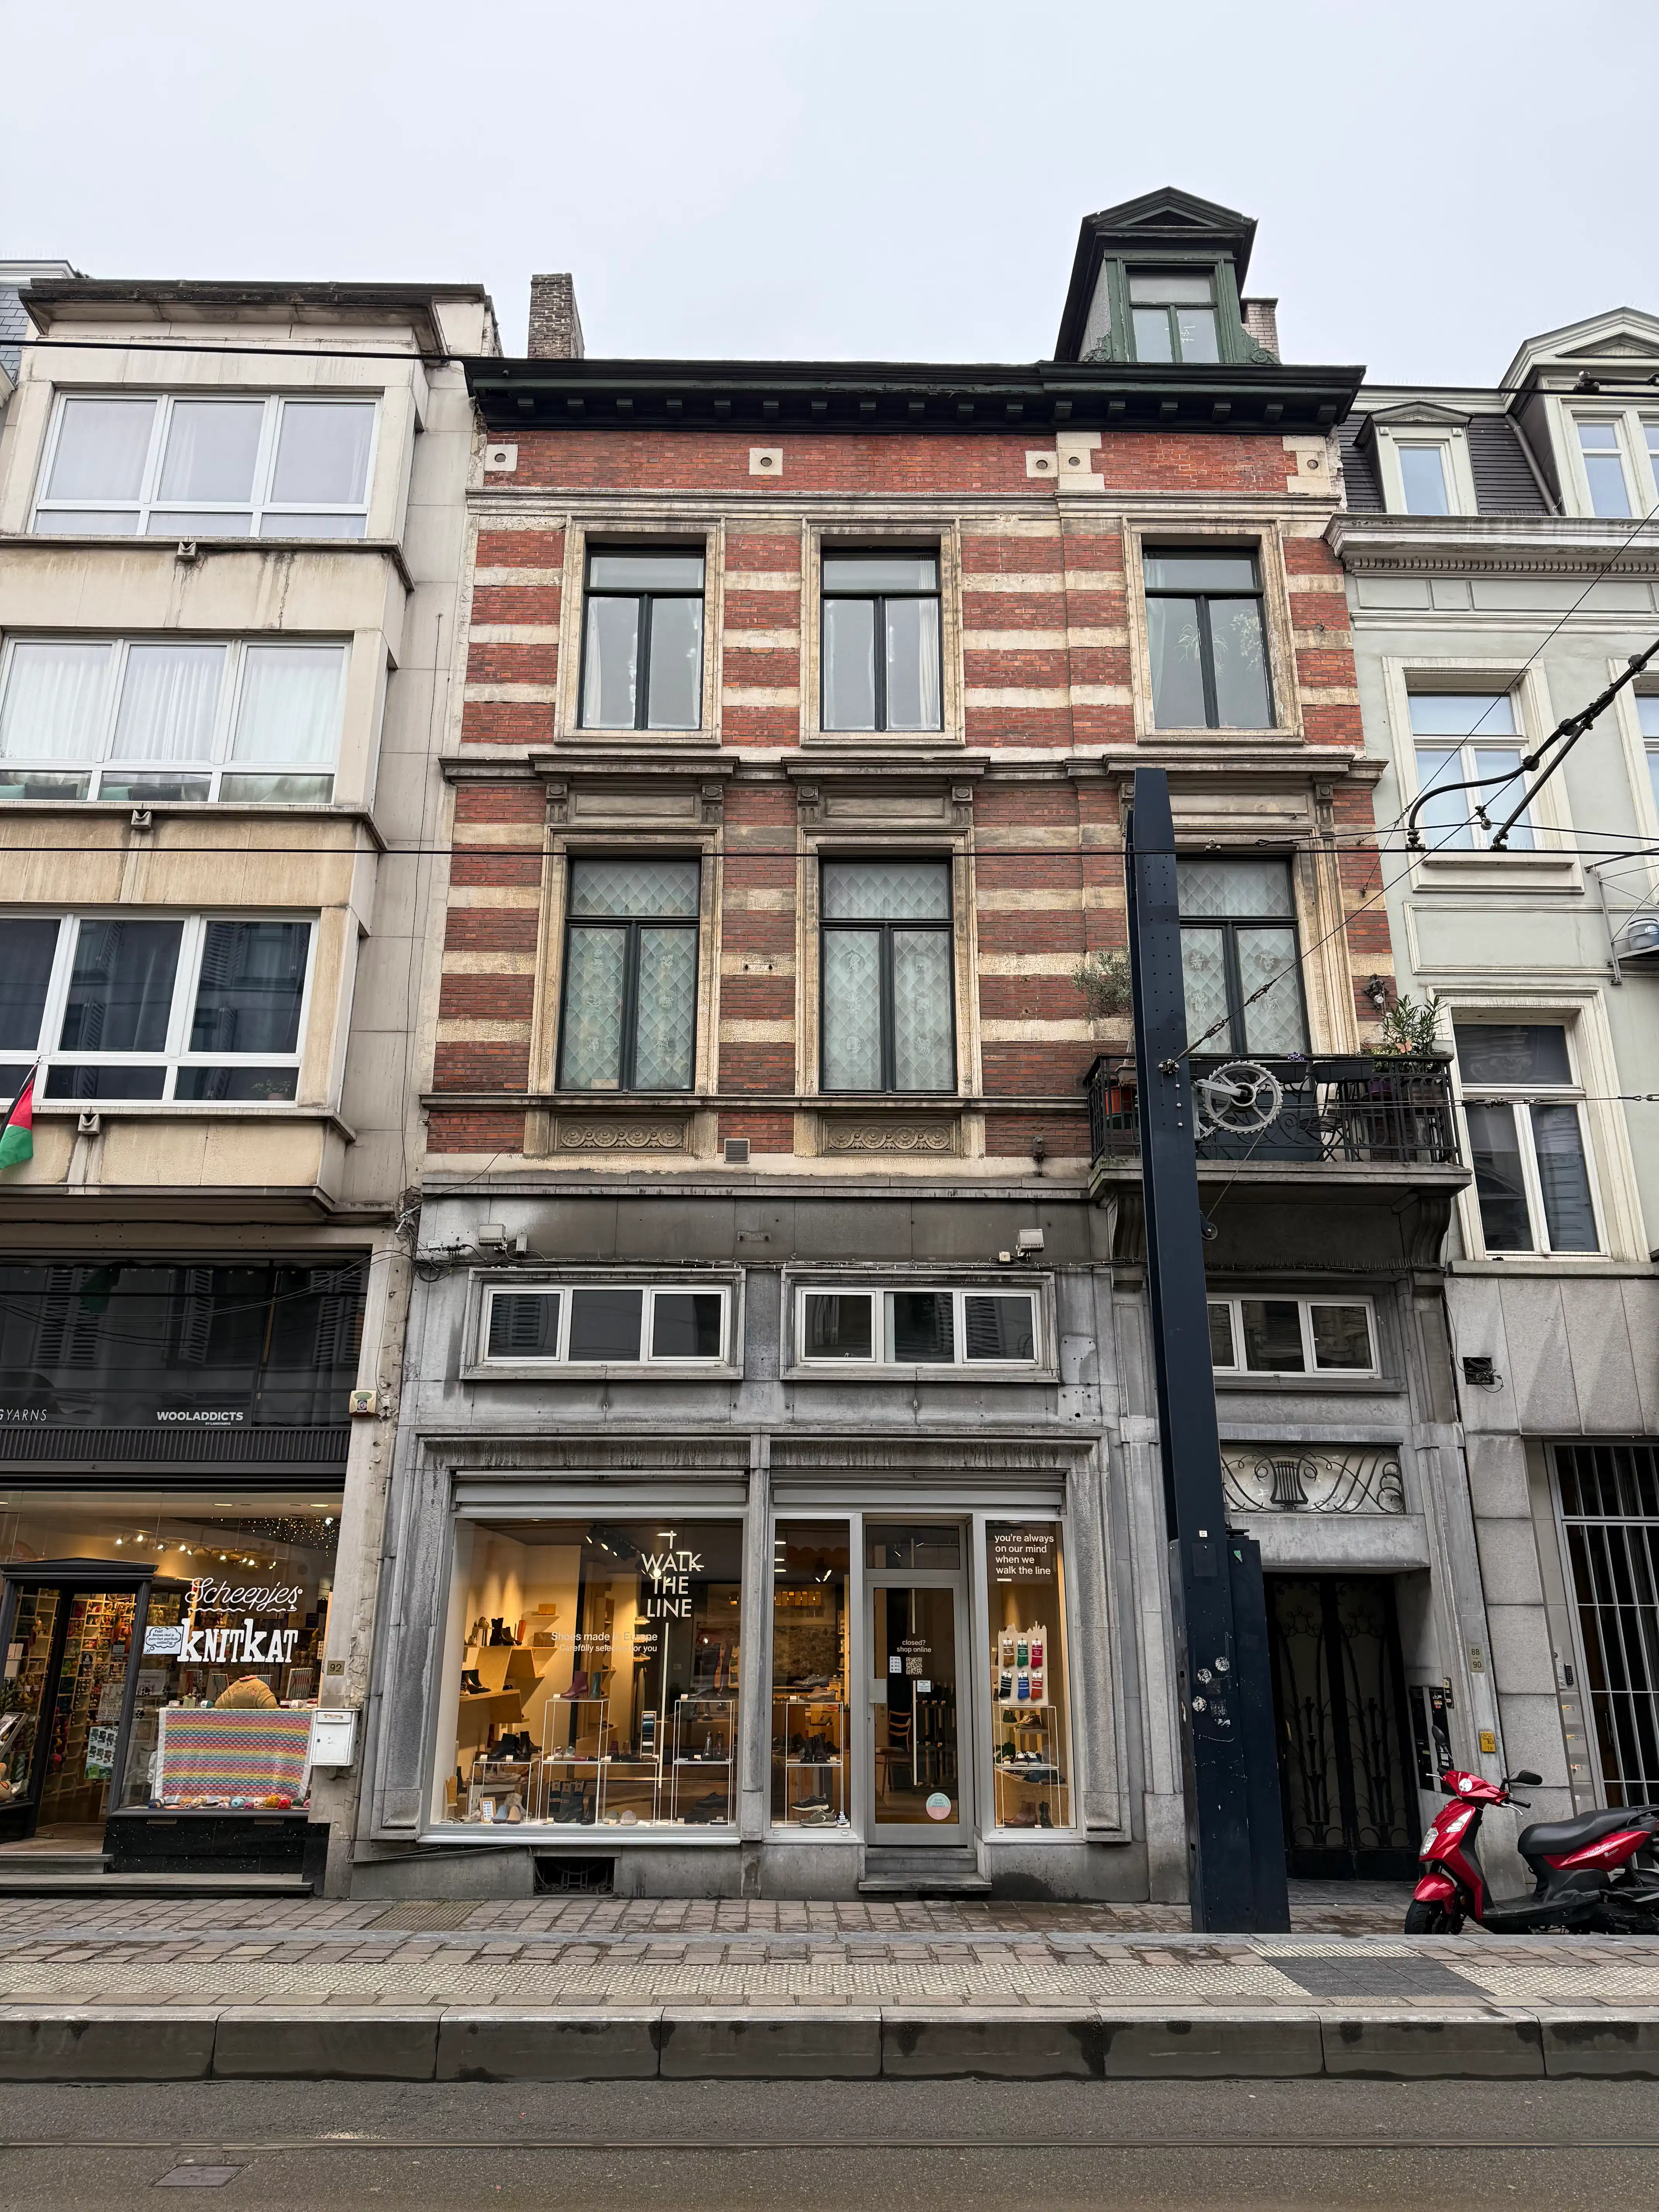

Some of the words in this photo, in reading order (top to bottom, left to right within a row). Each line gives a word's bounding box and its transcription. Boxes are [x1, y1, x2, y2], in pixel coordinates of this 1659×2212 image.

[156, 1412, 244, 1421] WOOLADDICTS
[994, 1534, 1022, 1543] you're
[1024, 1534, 1054, 1544] always
[1025, 1545, 1047, 1553] mind
[641, 1553, 702, 1572] WALK
[996, 1555, 1019, 1563] when
[996, 1566, 1017, 1574] walk
[1019, 1566, 1033, 1574] the
[1035, 1566, 1051, 1575] line
[651, 1576, 689, 1594] THE
[647, 1598, 692, 1618] LINE
[551, 1632, 581, 1641] Shoes
[584, 1632, 610, 1641] made
[623, 1632, 658, 1642] Europe
[559, 1644, 594, 1653] Carefully
[330, 1664, 342, 1672] 92
